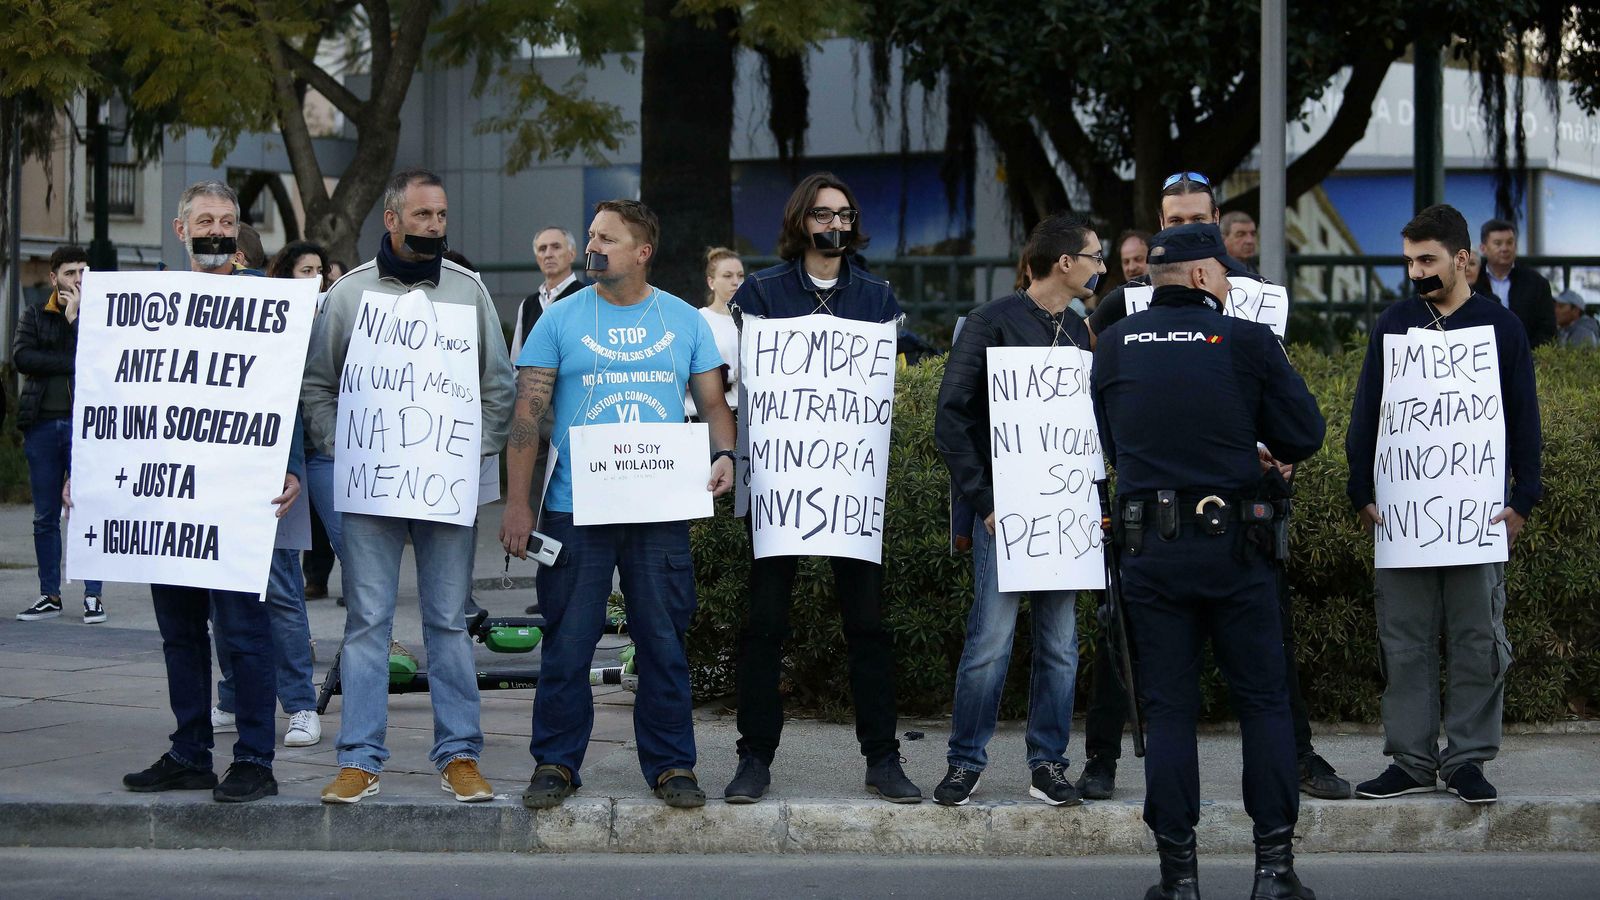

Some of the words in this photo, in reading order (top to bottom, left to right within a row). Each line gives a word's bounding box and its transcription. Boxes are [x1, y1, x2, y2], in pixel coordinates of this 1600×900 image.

[106, 292, 181, 331] TOD@S
[184, 293, 290, 334] IGUALES
[607, 327, 647, 345] STOP
[617, 351, 645, 362] FALSAS
[643, 346, 656, 358] DE
[1124, 331, 1208, 345] POLICIA
[114, 348, 167, 383] ANTE
[168, 348, 199, 384] LA
[206, 352, 257, 388] LEY
[755, 330, 893, 385] HOMBRE
[342, 363, 363, 393] NI
[371, 361, 415, 402] UNA
[423, 371, 473, 403] MENOS
[582, 374, 595, 386] NO
[597, 373, 604, 385] A
[605, 372, 629, 384] TODA
[630, 370, 674, 384] VIOLENCIA
[993, 369, 1018, 402] NI
[1025, 364, 1092, 402] ASESIN
[587, 391, 624, 420] CUSTODIA
[624, 390, 668, 420] COMPARTIDA
[615, 403, 641, 423] YA
[749, 388, 891, 426] MALTRATADO
[82, 406, 117, 439] POR
[123, 405, 158, 440] UNA
[163, 405, 281, 447] SOCIEDAD
[347, 405, 474, 458] NADIE
[993, 422, 1022, 459] NI
[589, 461, 607, 472] UN
[614, 459, 675, 470] VIOLADOR
[613, 444, 632, 454] NO
[637, 443, 661, 454] SOY
[751, 438, 876, 477] MINORÍA
[1376, 439, 1495, 484] MINORIA
[132, 463, 195, 500] JUSTA
[347, 462, 467, 516] MENOS
[1039, 463, 1097, 503] SOY
[754, 486, 884, 541] INVISIBLE
[1376, 495, 1502, 548] INVISIBLE
[103, 519, 219, 561] IGUALITARIA
[999, 508, 1103, 561] PERSO
